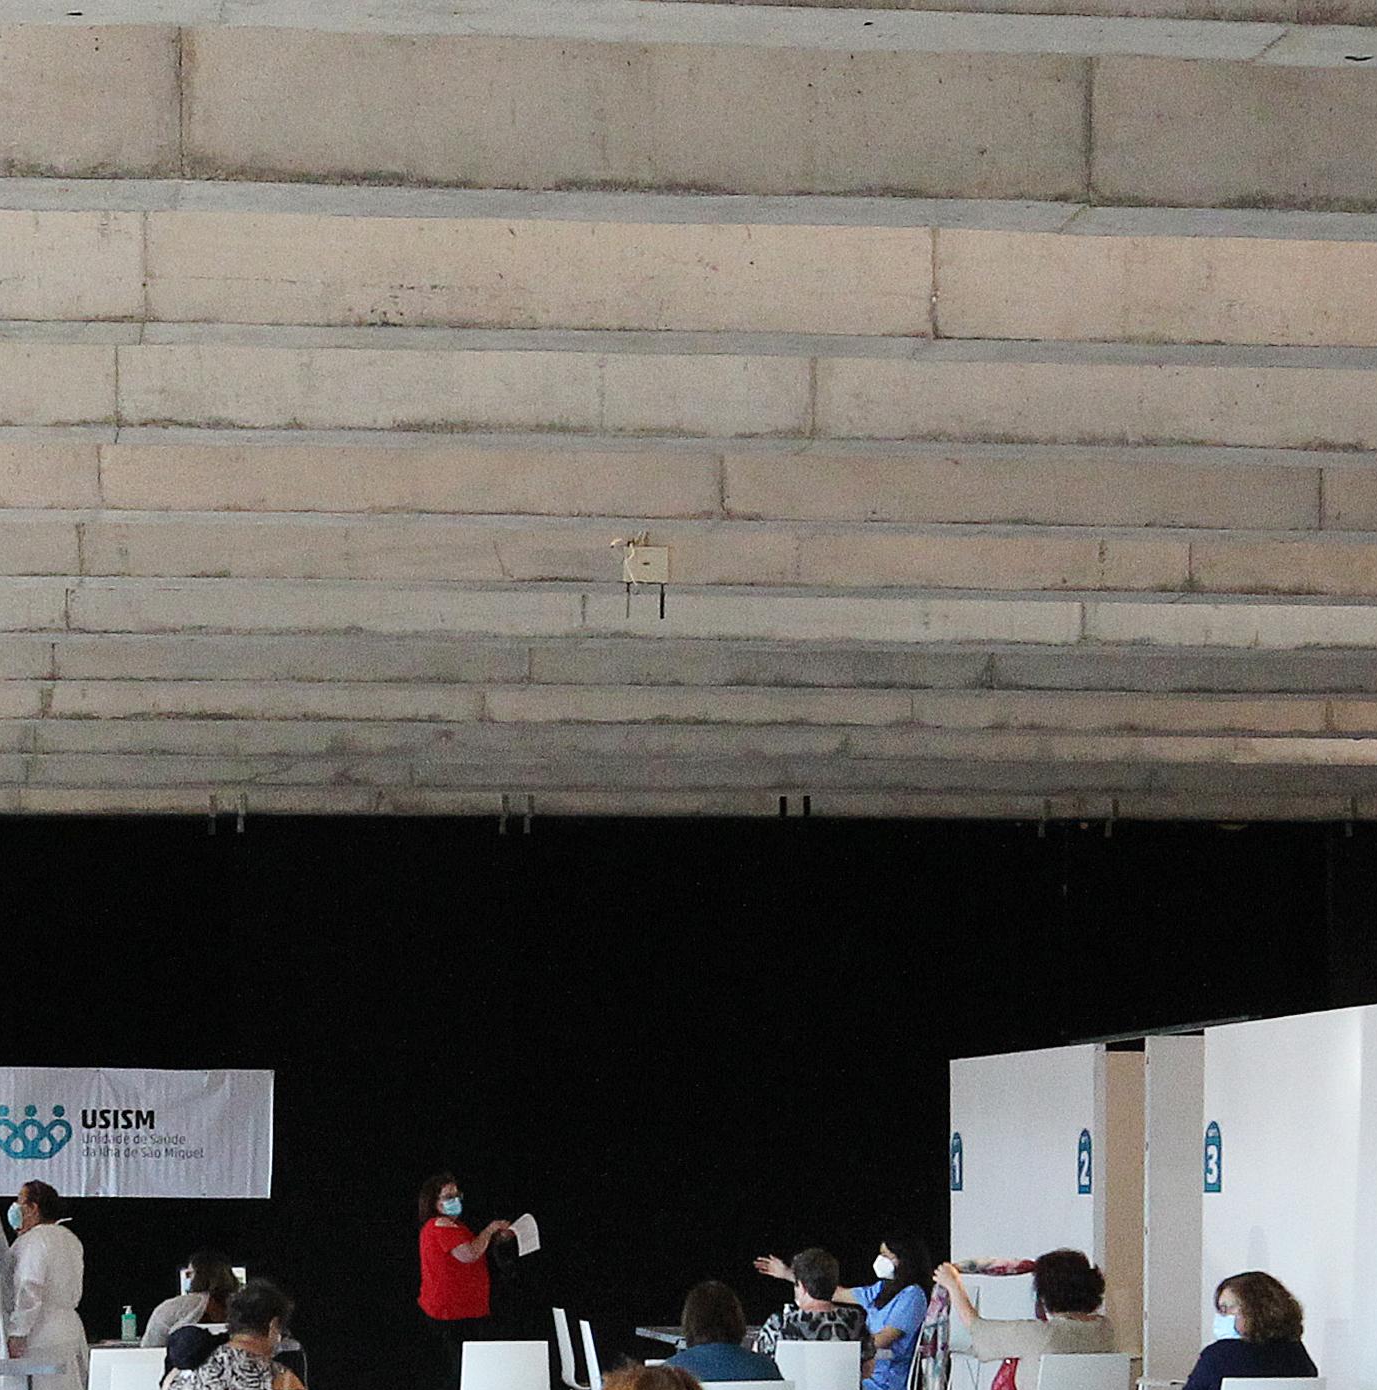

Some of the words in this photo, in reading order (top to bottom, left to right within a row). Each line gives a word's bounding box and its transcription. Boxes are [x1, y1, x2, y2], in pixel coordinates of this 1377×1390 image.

[81, 1109, 155, 1130] USISM
[82, 1133, 130, 1145] Unidade
[164, 1147, 204, 1160] Miguel
[1206, 1145, 1218, 1184] 3
[952, 1151, 960, 1183] 1
[1079, 1151, 1090, 1185] 2
